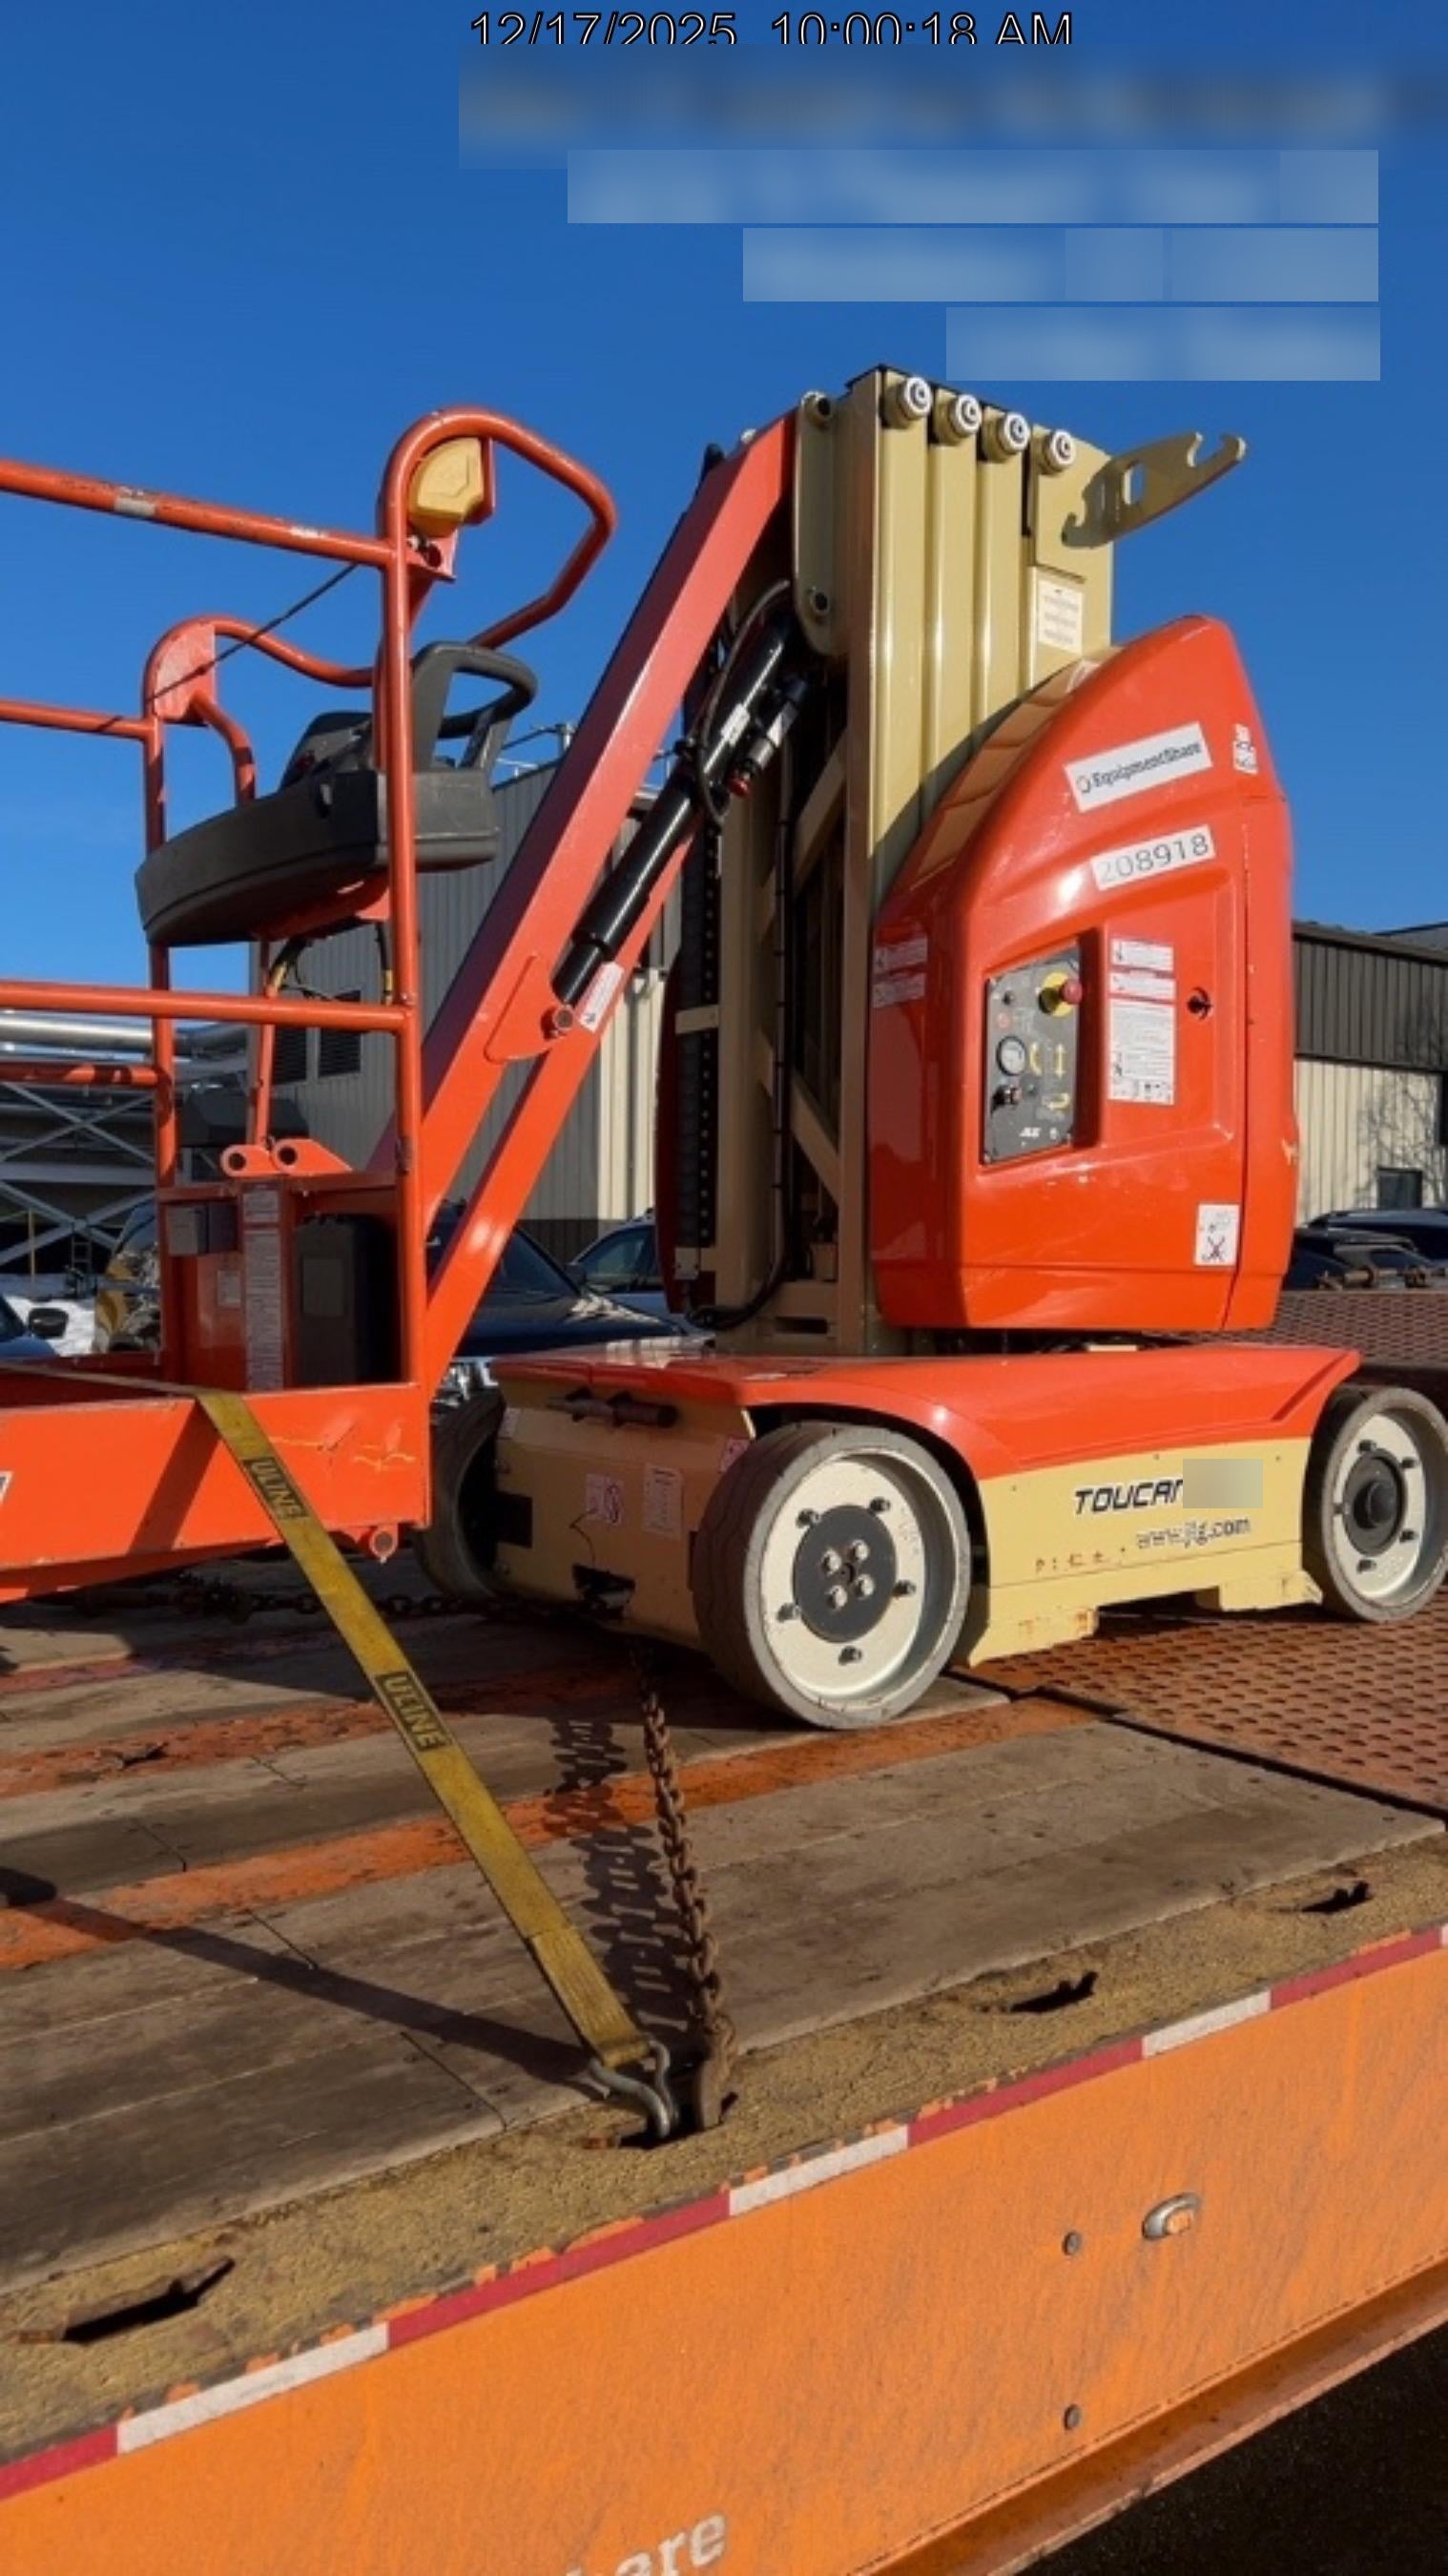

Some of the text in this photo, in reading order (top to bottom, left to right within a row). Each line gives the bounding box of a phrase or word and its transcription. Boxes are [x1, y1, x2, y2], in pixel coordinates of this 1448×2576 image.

[1100, 833, 1209, 883] 208918
[250, 1459, 302, 1520] ULINE
[384, 1676, 445, 1746] ULINE
[566, 2514, 726, 2576] are
